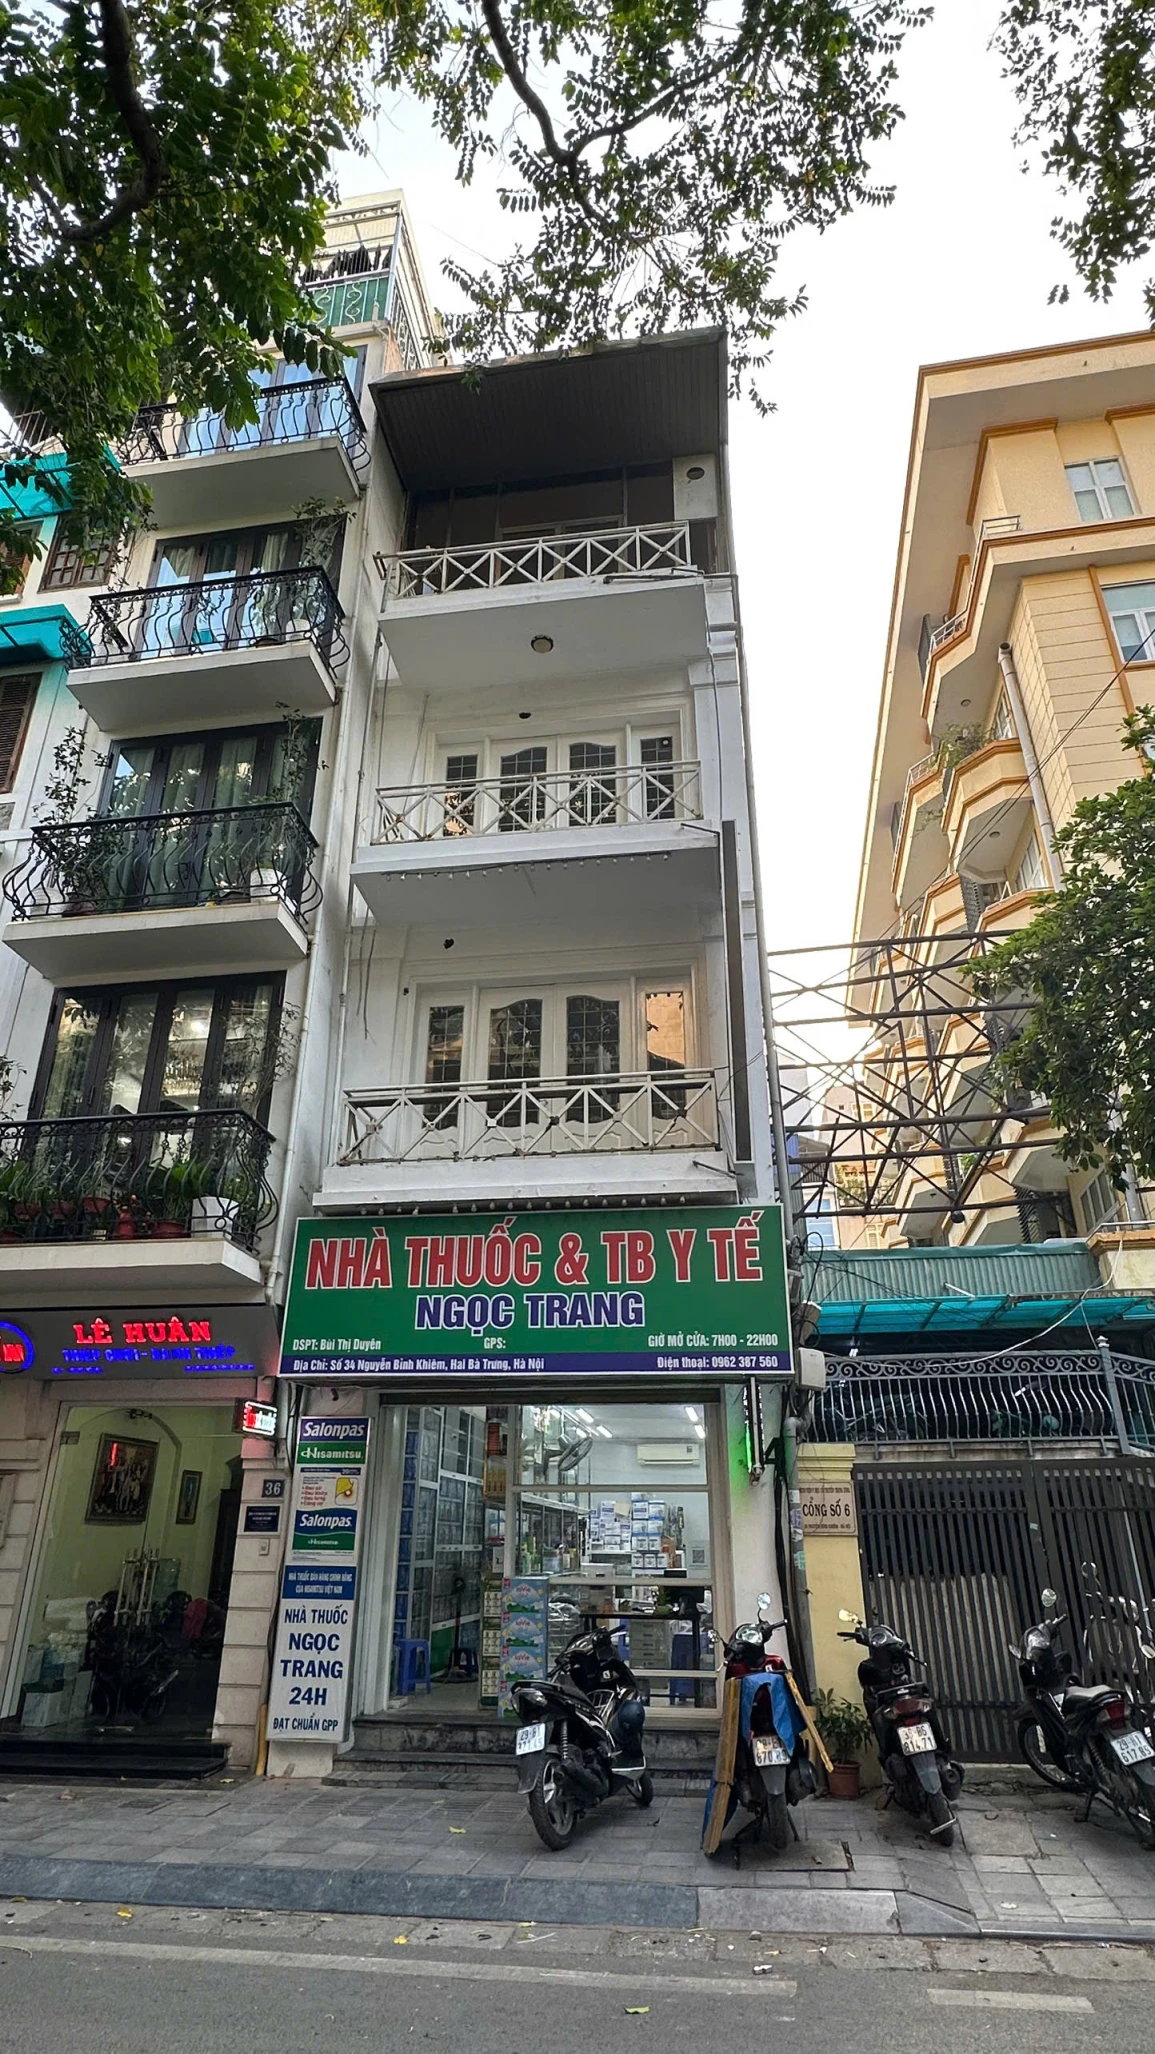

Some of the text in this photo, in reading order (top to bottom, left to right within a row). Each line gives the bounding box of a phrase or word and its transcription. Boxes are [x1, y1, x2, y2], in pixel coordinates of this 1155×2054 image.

[304, 1210, 765, 1290] NHÀ THUỐC & TB Y TẾ
[414, 1290, 646, 1337] NGỌC TRANG
[73, 1315, 212, 1344] LÊ HUÂN
[647, 1331, 665, 1347] GIỜ
[667, 1330, 684, 1347] MỞ
[686, 1330, 710, 1347] CỬA:
[711, 1334, 737, 1347] 7H00
[746, 1333, 778, 1346] 22H00
[292, 1338, 318, 1351] DSPT:
[483, 1336, 507, 1349] GPS:
[330, 1358, 343, 1371] Số
[344, 1360, 356, 1371] 34
[357, 1357, 391, 1371] Nguyễn
[450, 1358, 466, 1370] Hai
[468, 1358, 480, 1370] Bà
[513, 1358, 526, 1370] Hà
[528, 1358, 545, 1372] Nội
[657, 1356, 778, 1370] Điện thoại: 0962 387 560
[302, 1421, 366, 1439] Salonpas
[265, 1482, 281, 1496] 36
[802, 1496, 828, 1517] CỔNG
[829, 1498, 842, 1517] SỐ
[844, 1503, 851, 1517] 6
[299, 1513, 353, 1530] Salonpas
[284, 1604, 348, 1625] NHÀ THUỐC
[288, 1633, 340, 1655] NGỌC
[280, 1660, 343, 1679] TRANG
[289, 1687, 327, 1706] 24H
[273, 1713, 339, 1732] ĐẠT CHUẨN GPP
